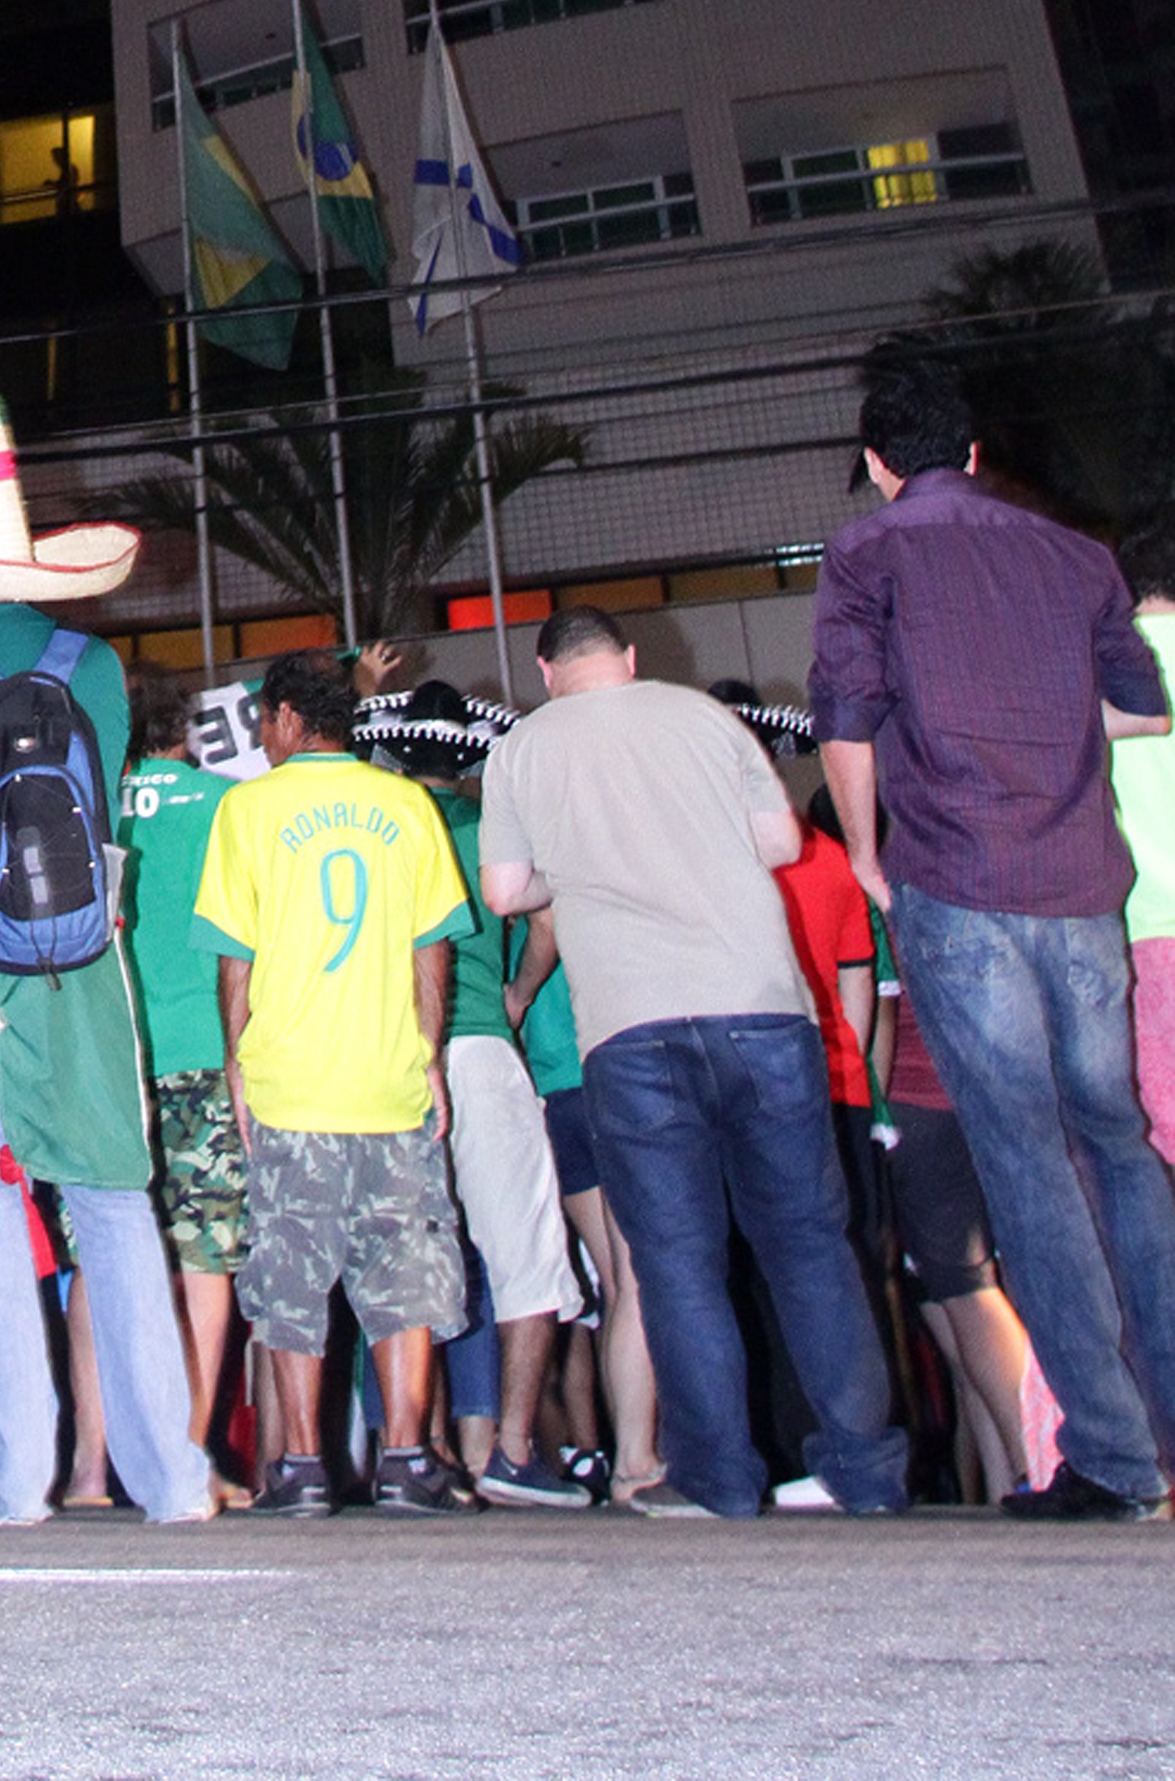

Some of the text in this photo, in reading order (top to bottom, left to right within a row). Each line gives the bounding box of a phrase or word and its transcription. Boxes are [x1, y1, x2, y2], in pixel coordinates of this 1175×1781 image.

[122, 787, 160, 818] 10
[279, 801, 400, 854] RONALDO
[320, 847, 369, 973] 9
